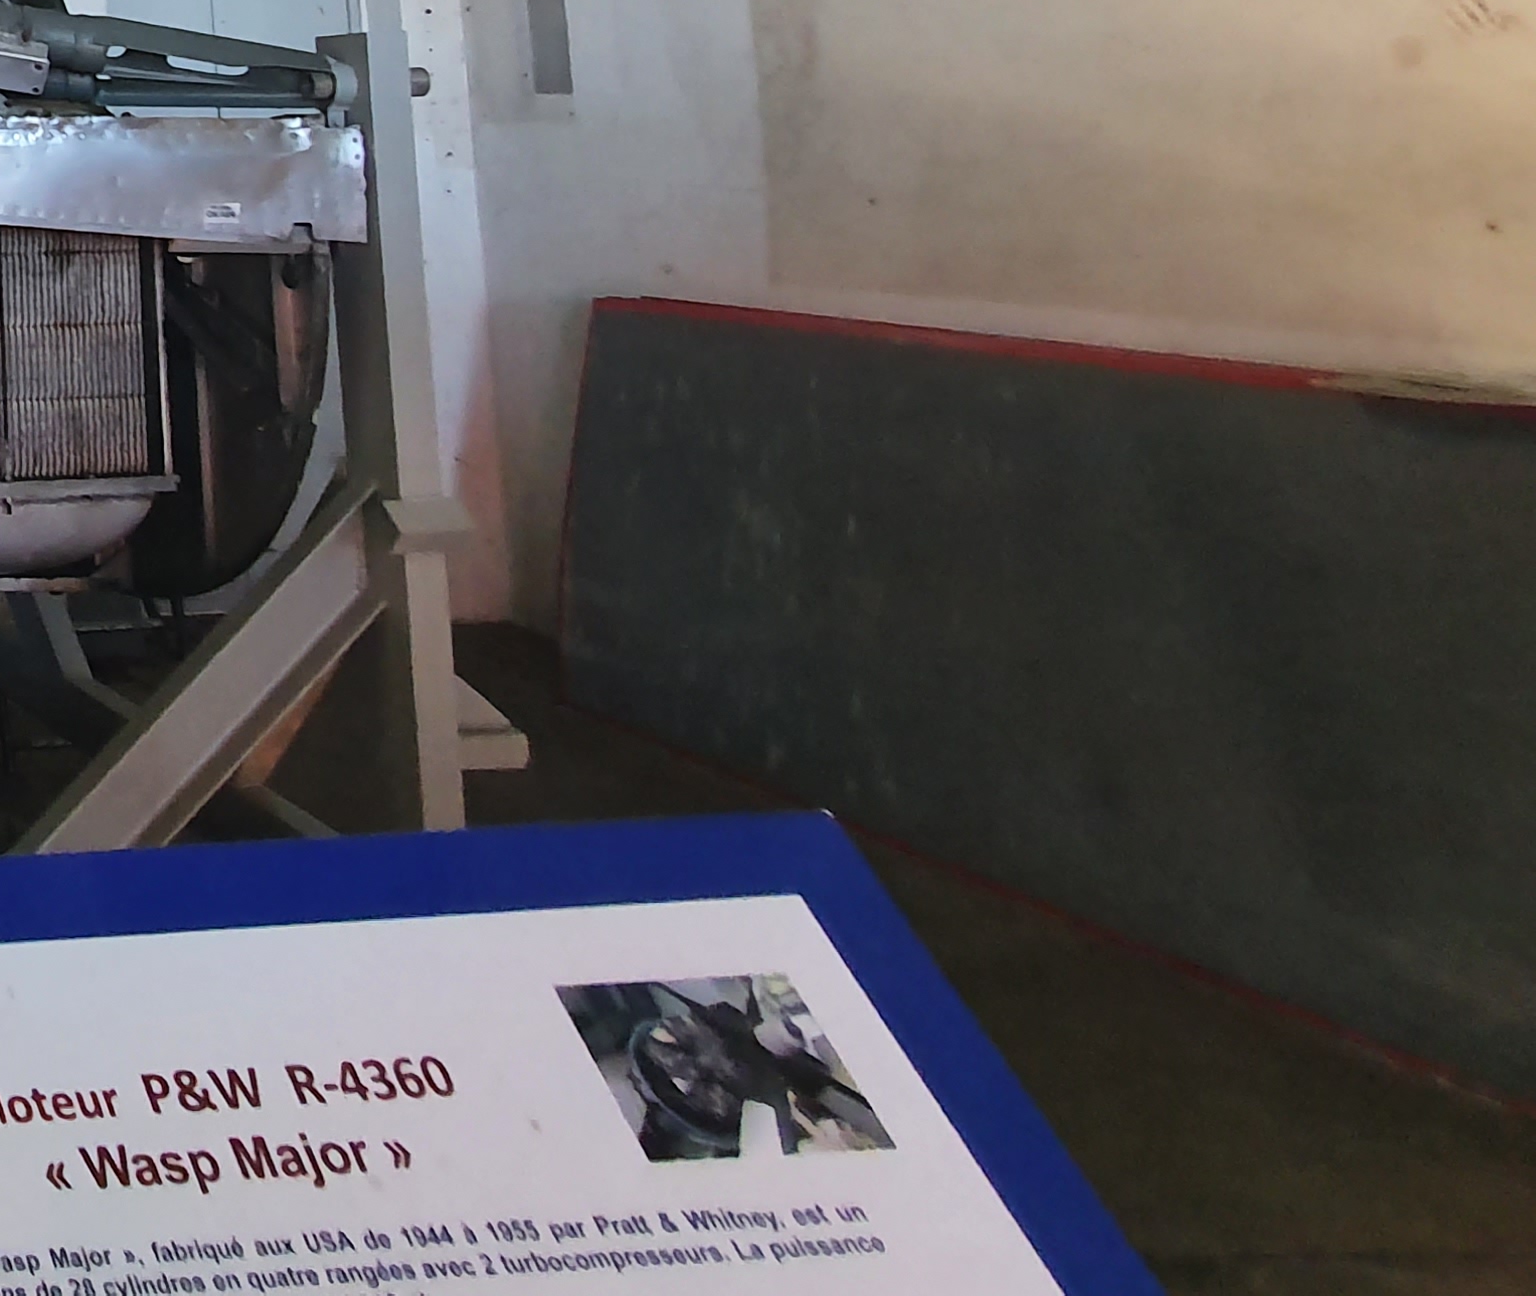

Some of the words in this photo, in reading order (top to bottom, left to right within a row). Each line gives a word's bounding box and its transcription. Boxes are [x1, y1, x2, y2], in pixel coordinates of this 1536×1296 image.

[140, 1066, 262, 1114] P&W
[284, 1054, 455, 1106] R-4360
[45, 1159, 73, 1190] «
[78, 1143, 221, 1195] Wasp
[228, 1132, 368, 1188] Major
[382, 1138, 412, 1170] »
[36, 1279, 62, 1296] de
[68, 1277, 96, 1296] 28
[103, 1272, 206, 1296] cylindres
[212, 1273, 242, 1291] en
[247, 1267, 320, 1294] quatre
[326, 1258, 417, 1289] rangées
[422, 1260, 477, 1280] avec
[479, 1253, 499, 1276] 2
[500, 1246, 731, 1275] turbocompresseurs.
[730, 1239, 766, 1262] La
[769, 1235, 886, 1264] puissance
[49, 1246, 111, 1273] Major
[151, 1235, 245, 1265] fabriqué
[254, 1239, 297, 1257] aux
[302, 1229, 356, 1253] USA
[363, 1228, 392, 1250] de
[400, 1223, 455, 1248] 1944
[461, 1220, 478, 1246] à
[486, 1218, 540, 1243] 1955
[549, 1222, 587, 1244] par
[592, 1214, 655, 1237] Pratt
[658, 1212, 679, 1233] &
[681, 1207, 786, 1232] Whitney,
[791, 1203, 832, 1227] est
[835, 1206, 869, 1222] un
